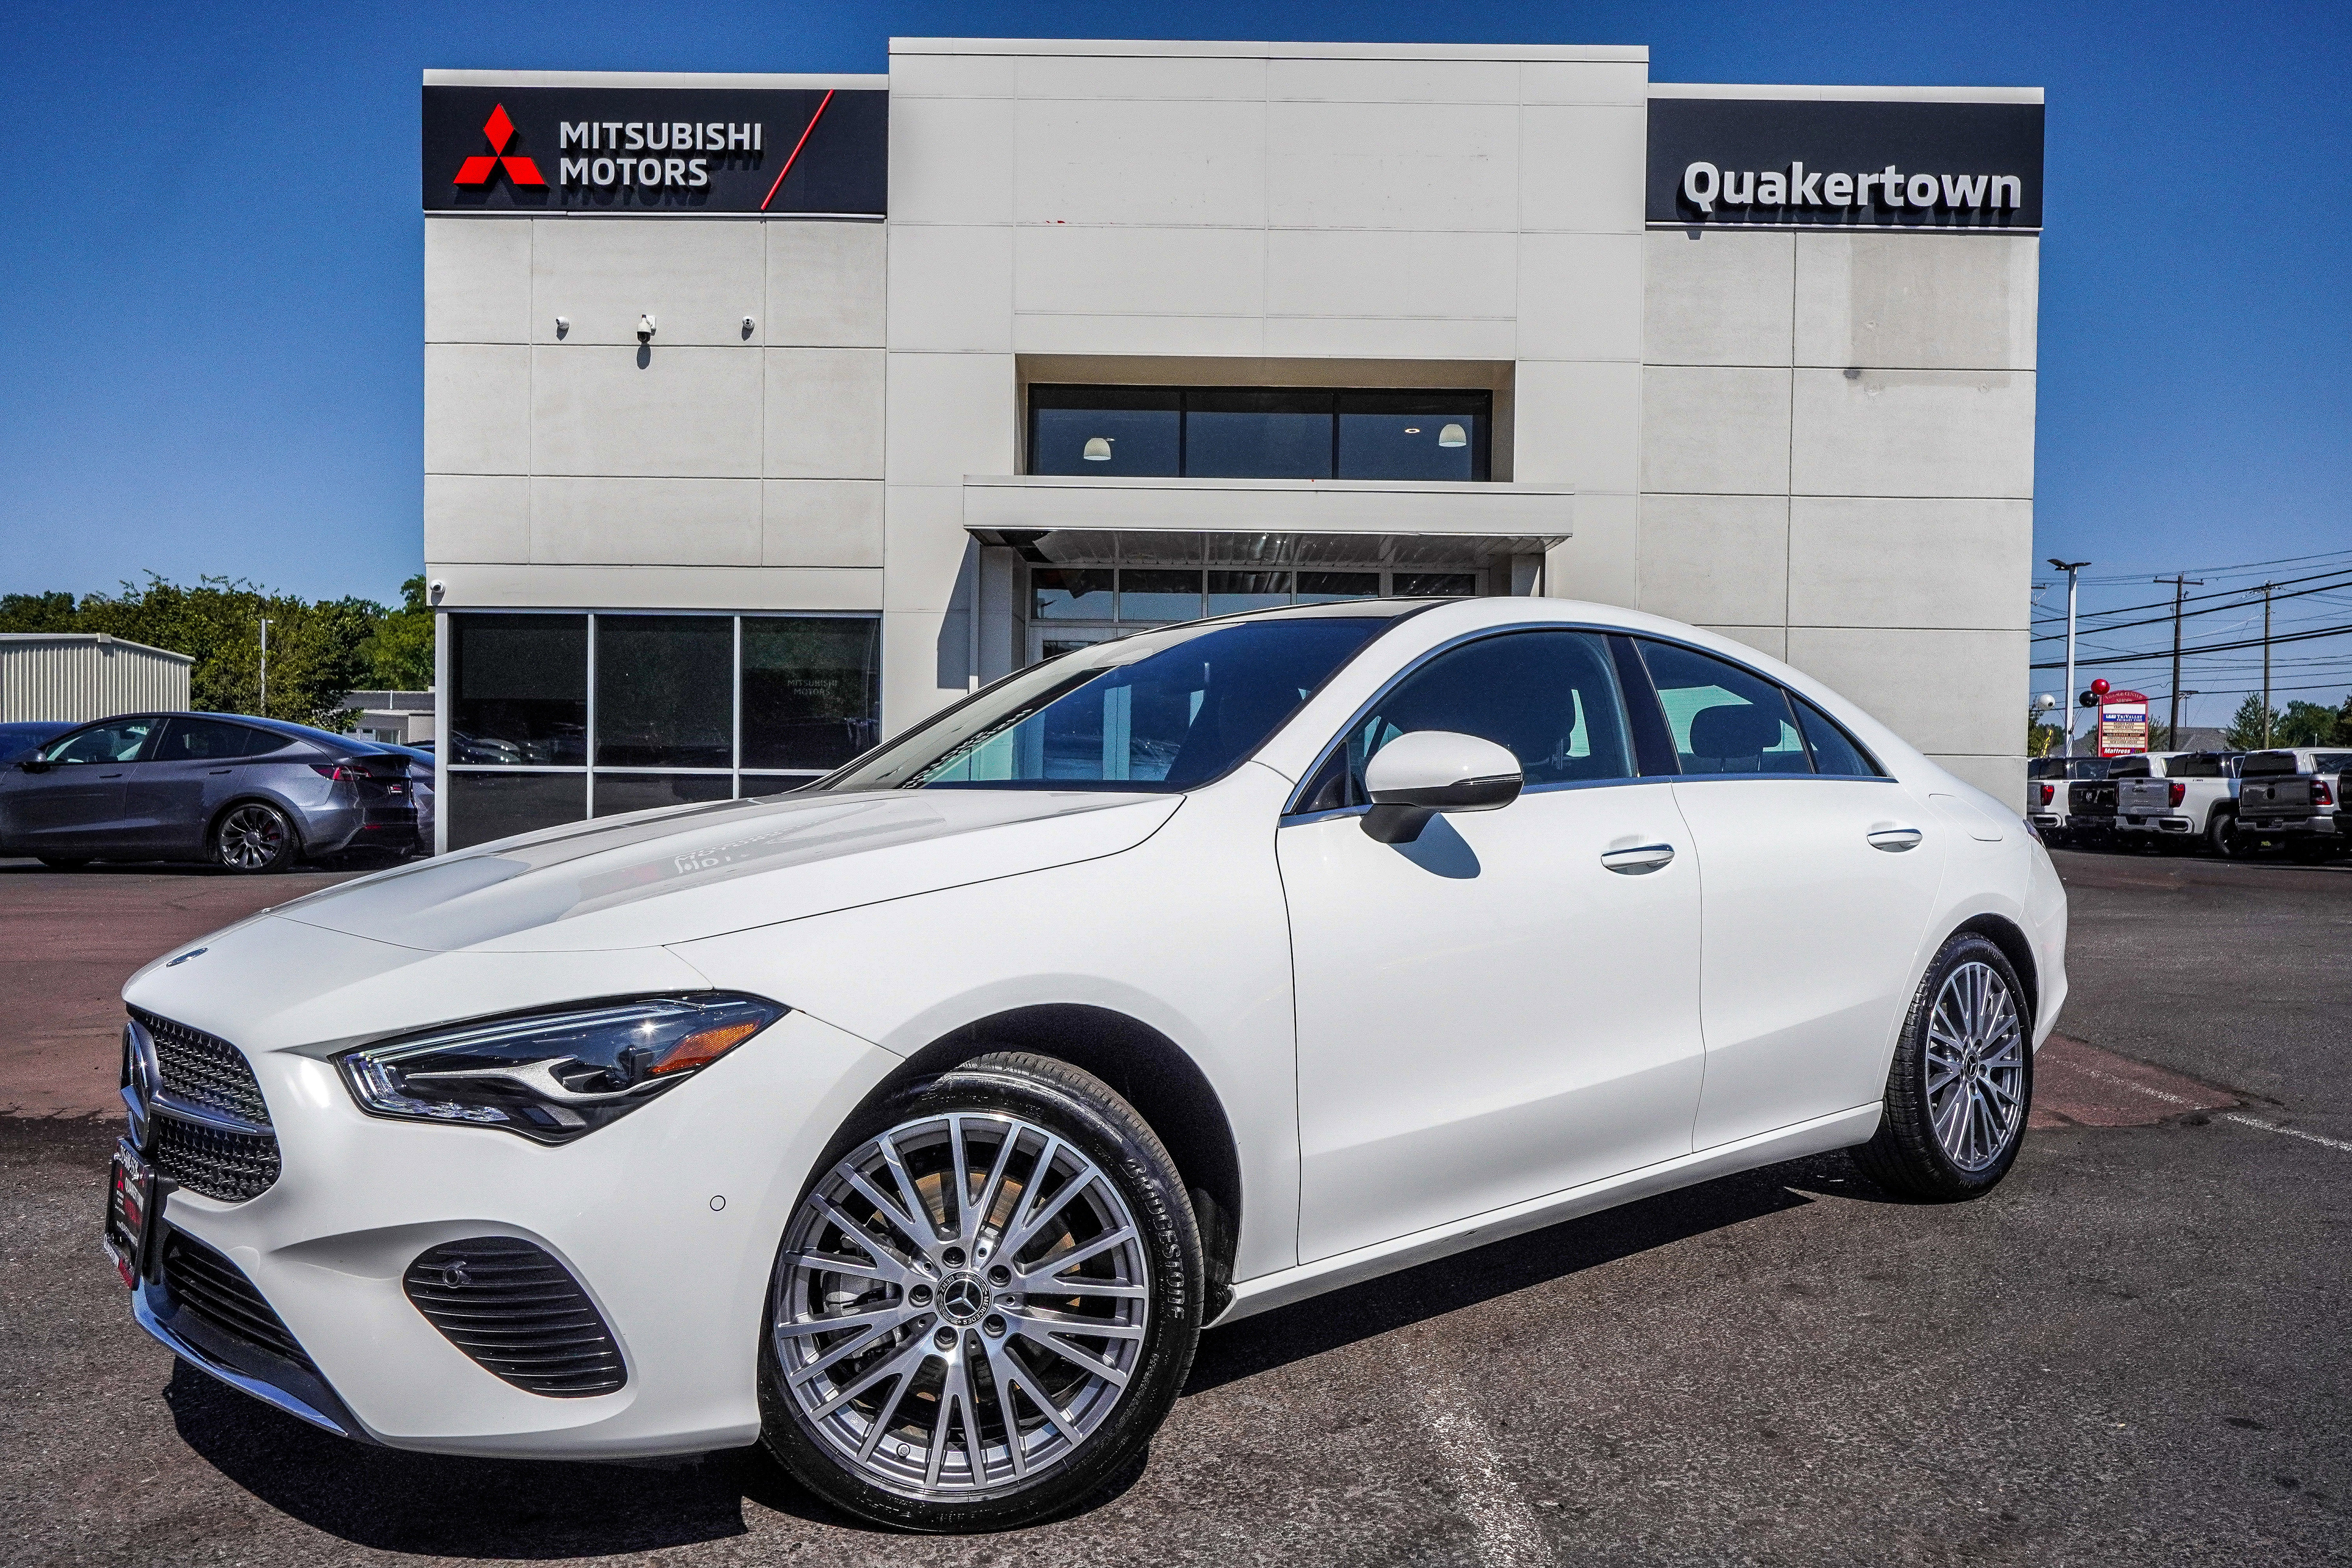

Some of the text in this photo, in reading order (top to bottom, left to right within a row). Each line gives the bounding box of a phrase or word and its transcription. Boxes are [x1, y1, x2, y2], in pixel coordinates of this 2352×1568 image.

[560, 121, 762, 150] MITSUBISHI
[560, 158, 708, 186] MOTORS
[1684, 162, 2021, 212] Quakertown
[939, 1275, 989, 1325] MERCEDES BENZ
